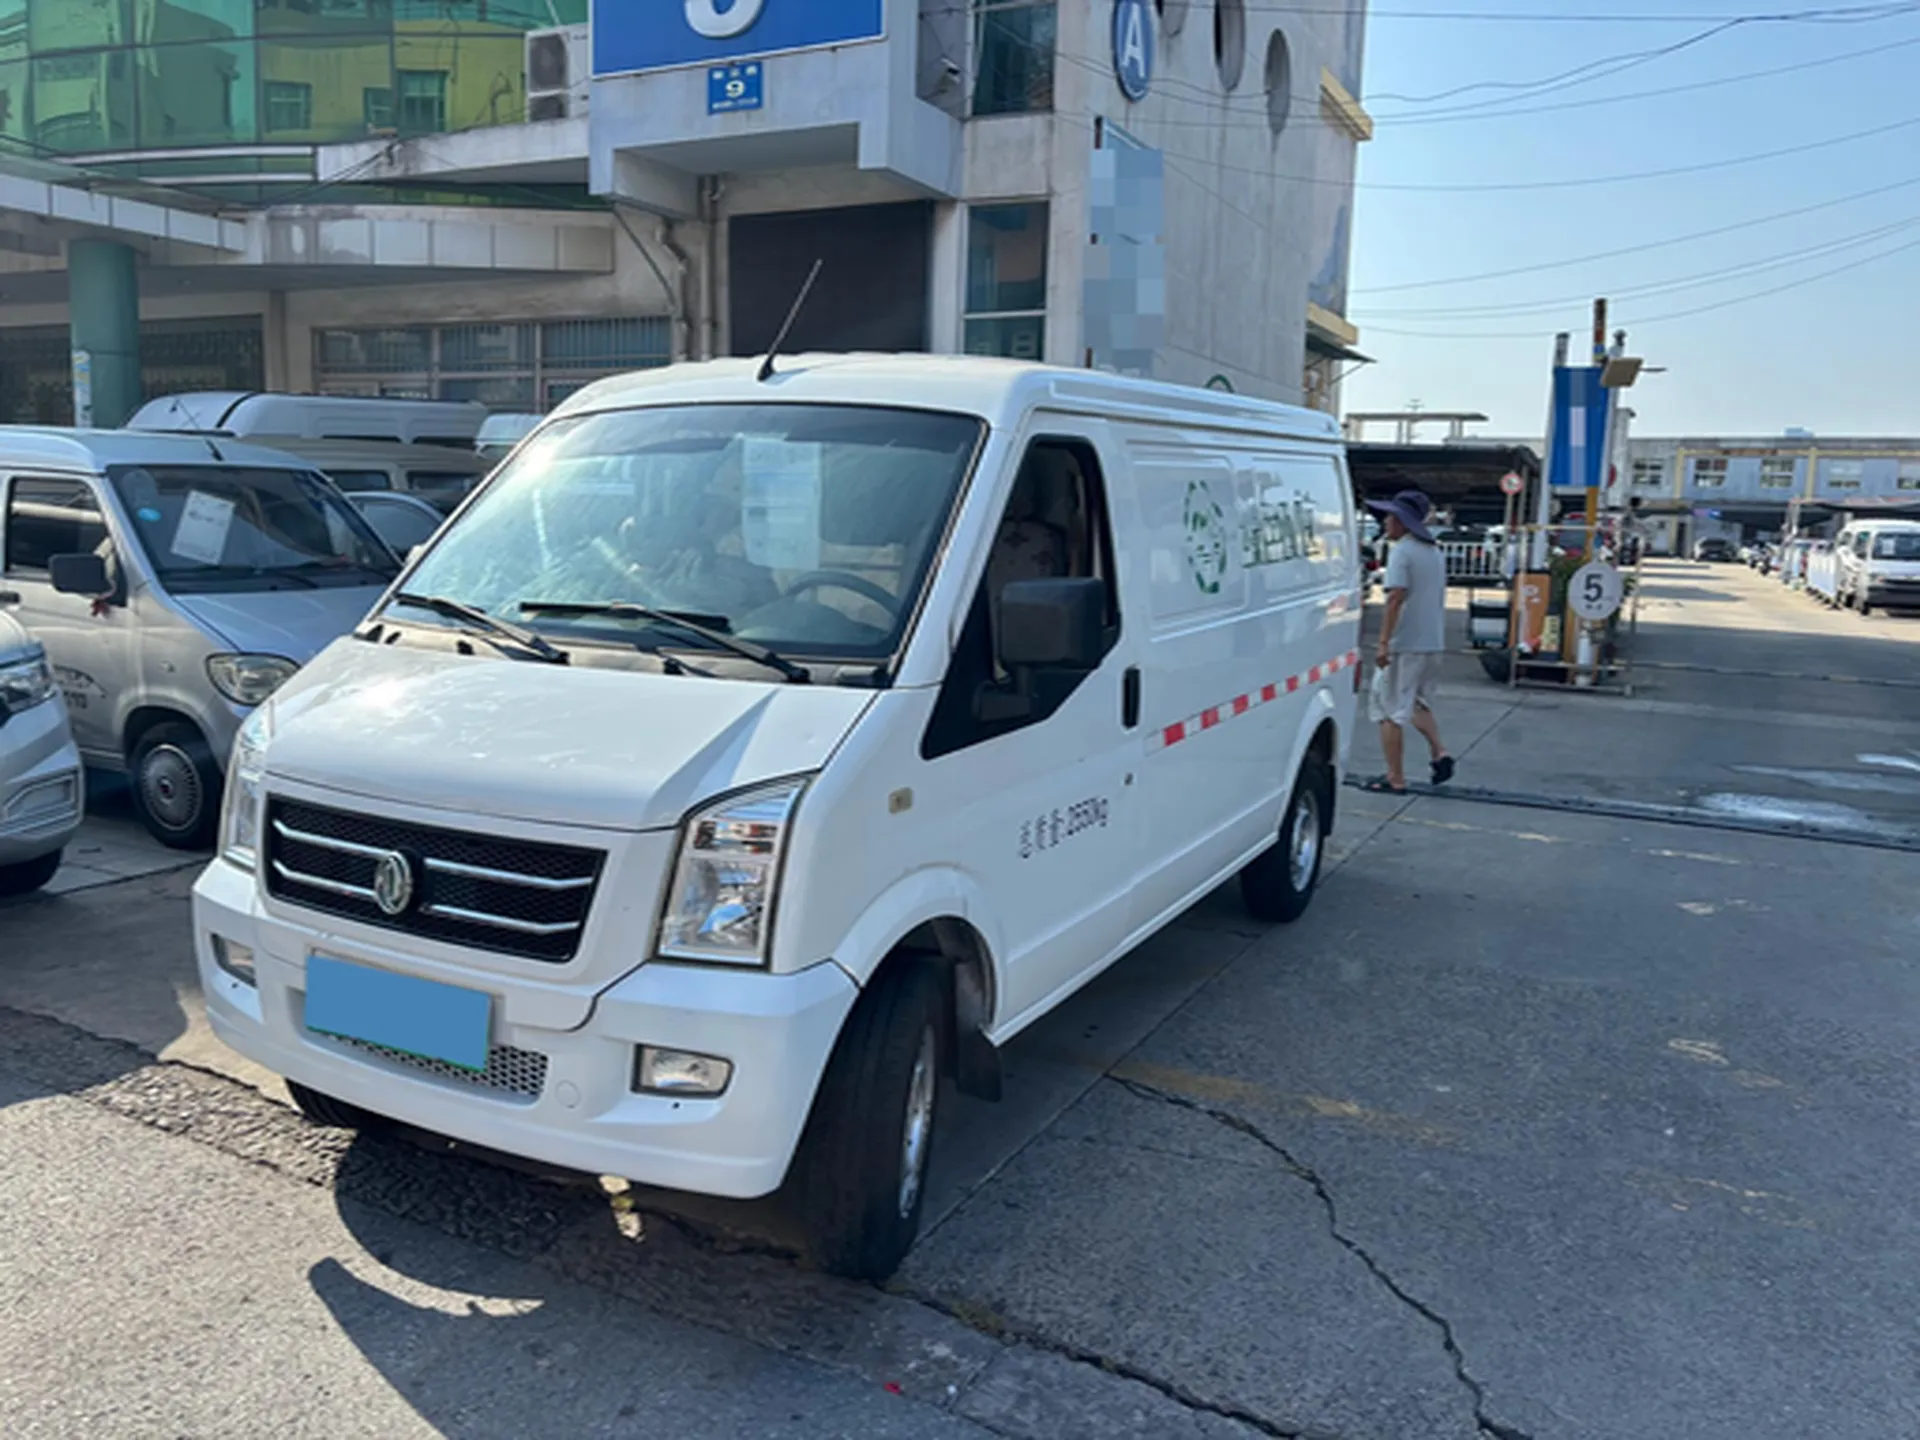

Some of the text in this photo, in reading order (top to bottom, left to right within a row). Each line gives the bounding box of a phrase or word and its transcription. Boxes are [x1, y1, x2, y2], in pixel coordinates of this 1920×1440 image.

[1121, 3, 1145, 79] A
[725, 79, 745, 99] 9
[1583, 573, 1604, 603] 5
